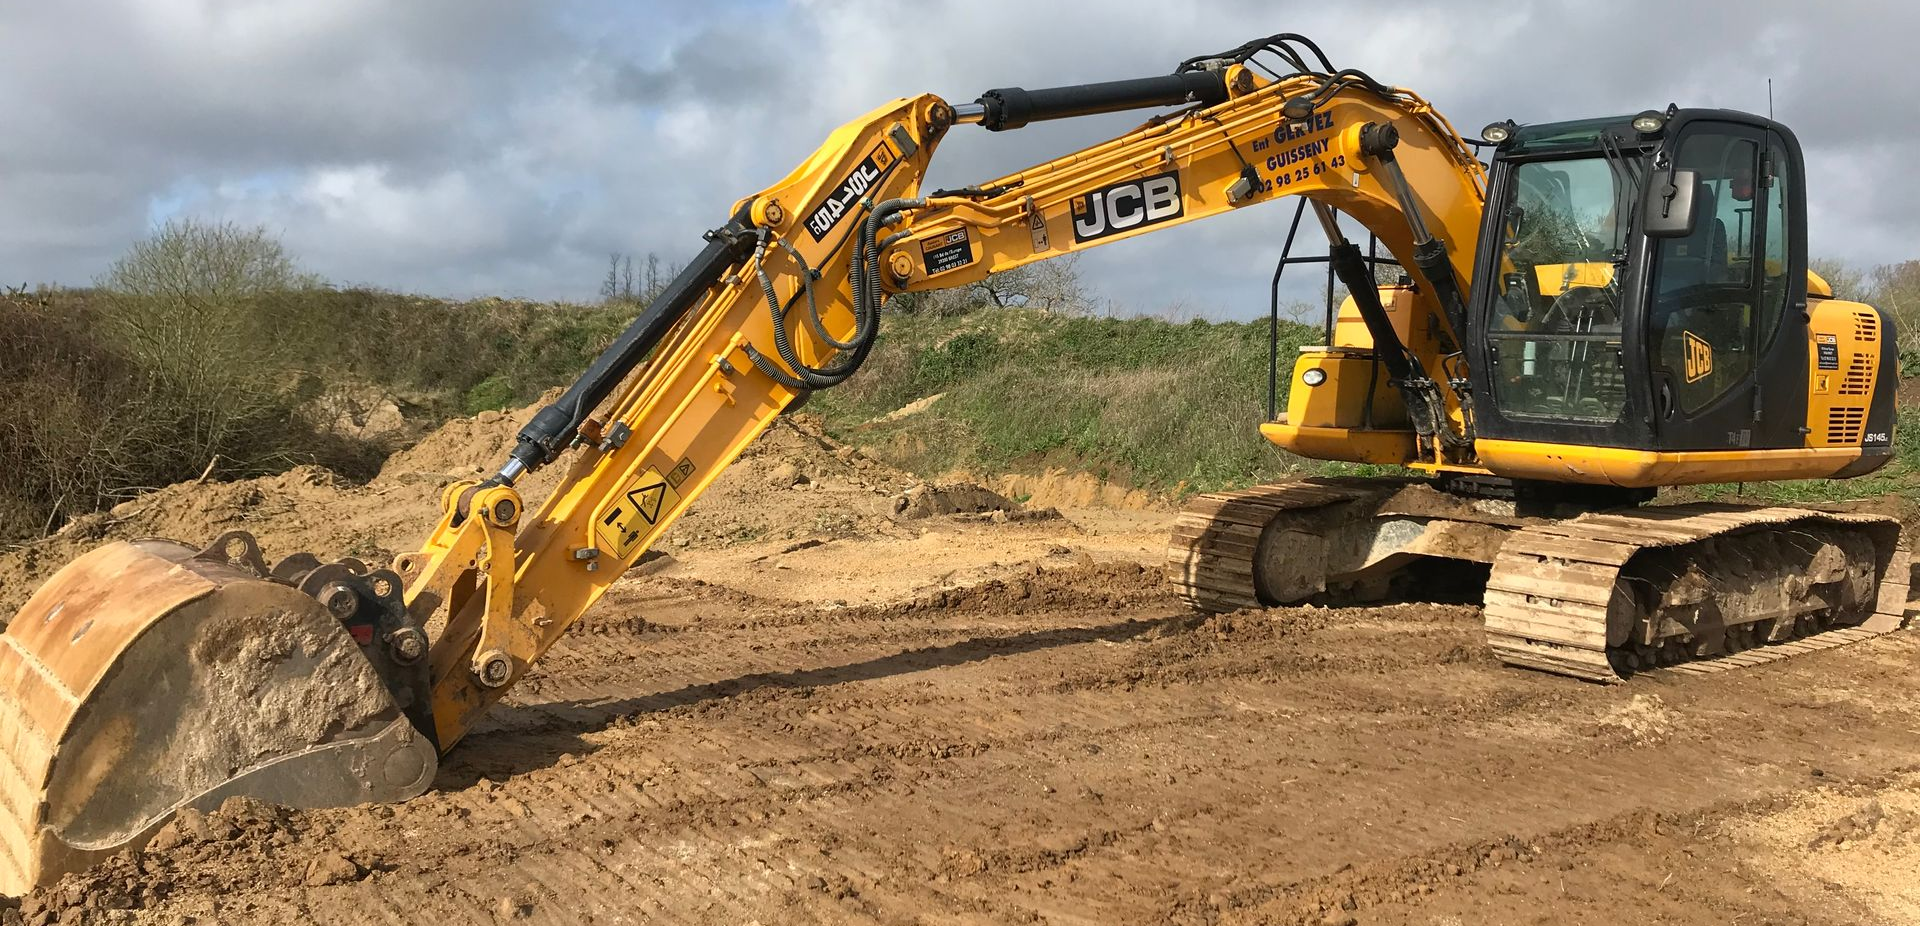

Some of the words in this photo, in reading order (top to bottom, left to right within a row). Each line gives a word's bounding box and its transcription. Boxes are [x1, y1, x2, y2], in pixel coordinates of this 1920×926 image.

[1252, 137, 1269, 152] Ent
[1266, 137, 1329, 171] GUISSENY
[1259, 179, 1273, 194] 02
[1276, 173, 1291, 188] 98
[1295, 166, 1309, 182] 25
[1313, 161, 1326, 175] 61
[1331, 155, 1345, 169] 43
[1075, 176, 1180, 238] JCB
[946, 231, 965, 243] JCB
[1687, 337, 1710, 377] JCB
[1864, 432, 1886, 443] JS145
